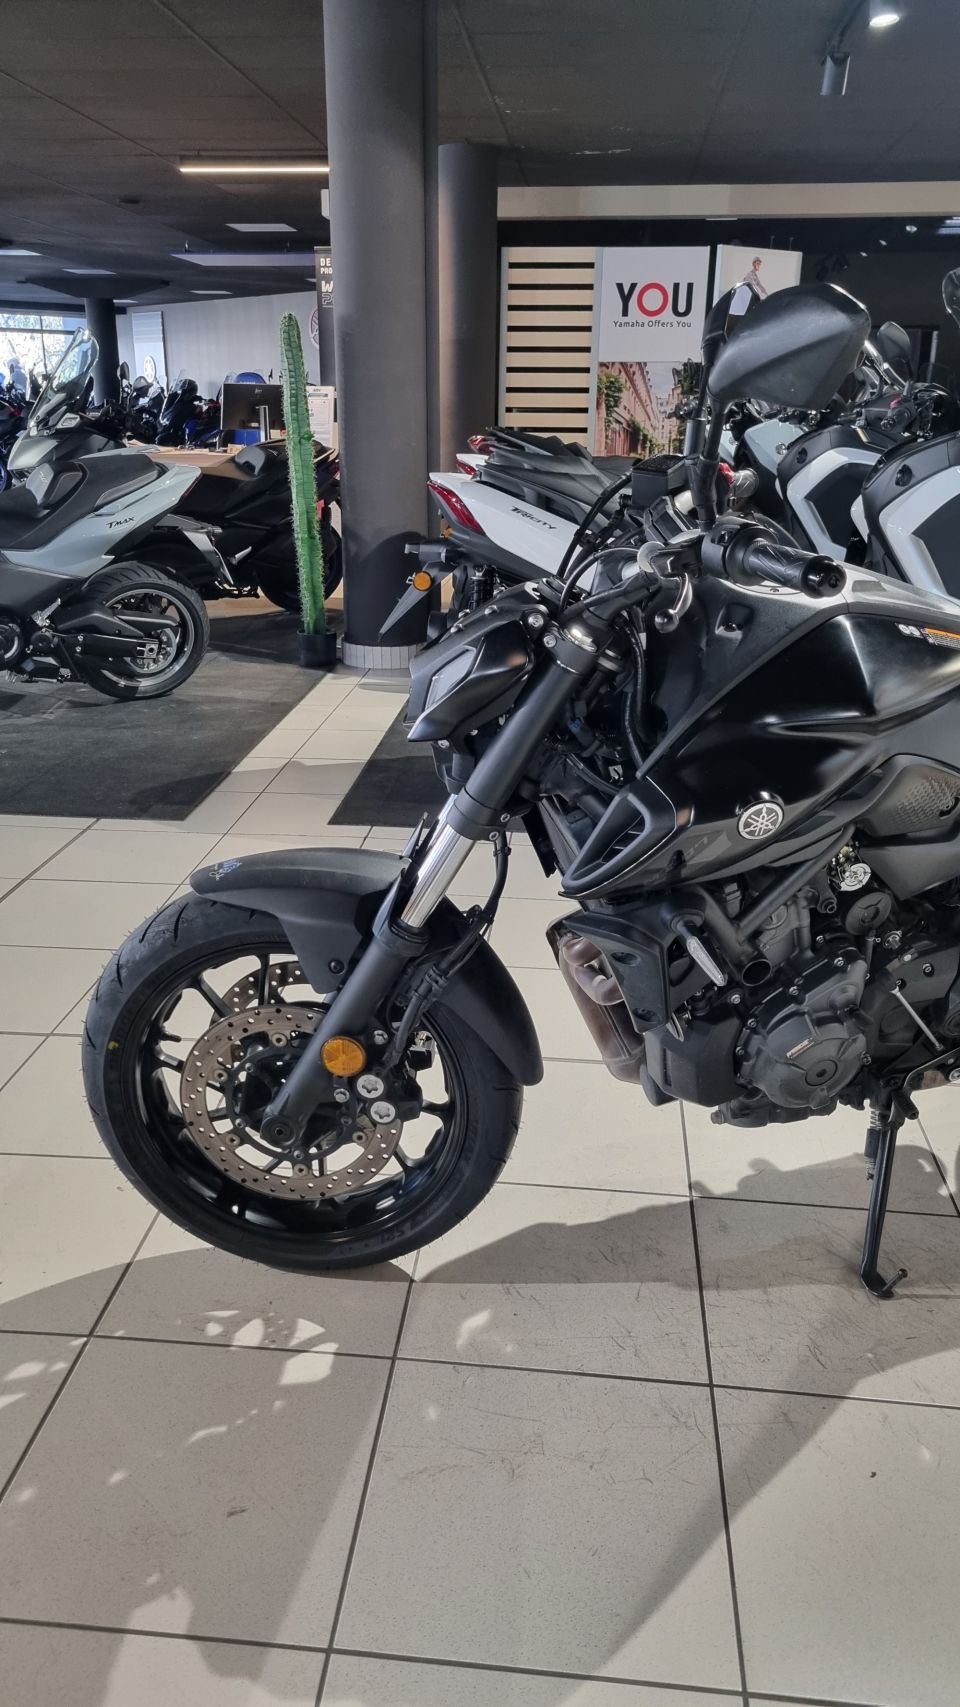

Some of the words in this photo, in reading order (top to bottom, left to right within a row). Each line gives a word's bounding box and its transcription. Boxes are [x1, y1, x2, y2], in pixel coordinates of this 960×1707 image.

[616, 282, 694, 318] YOU
[613, 320, 645, 328] Yamaha
[647, 320, 674, 328] Offers
[676, 320, 692, 328] You
